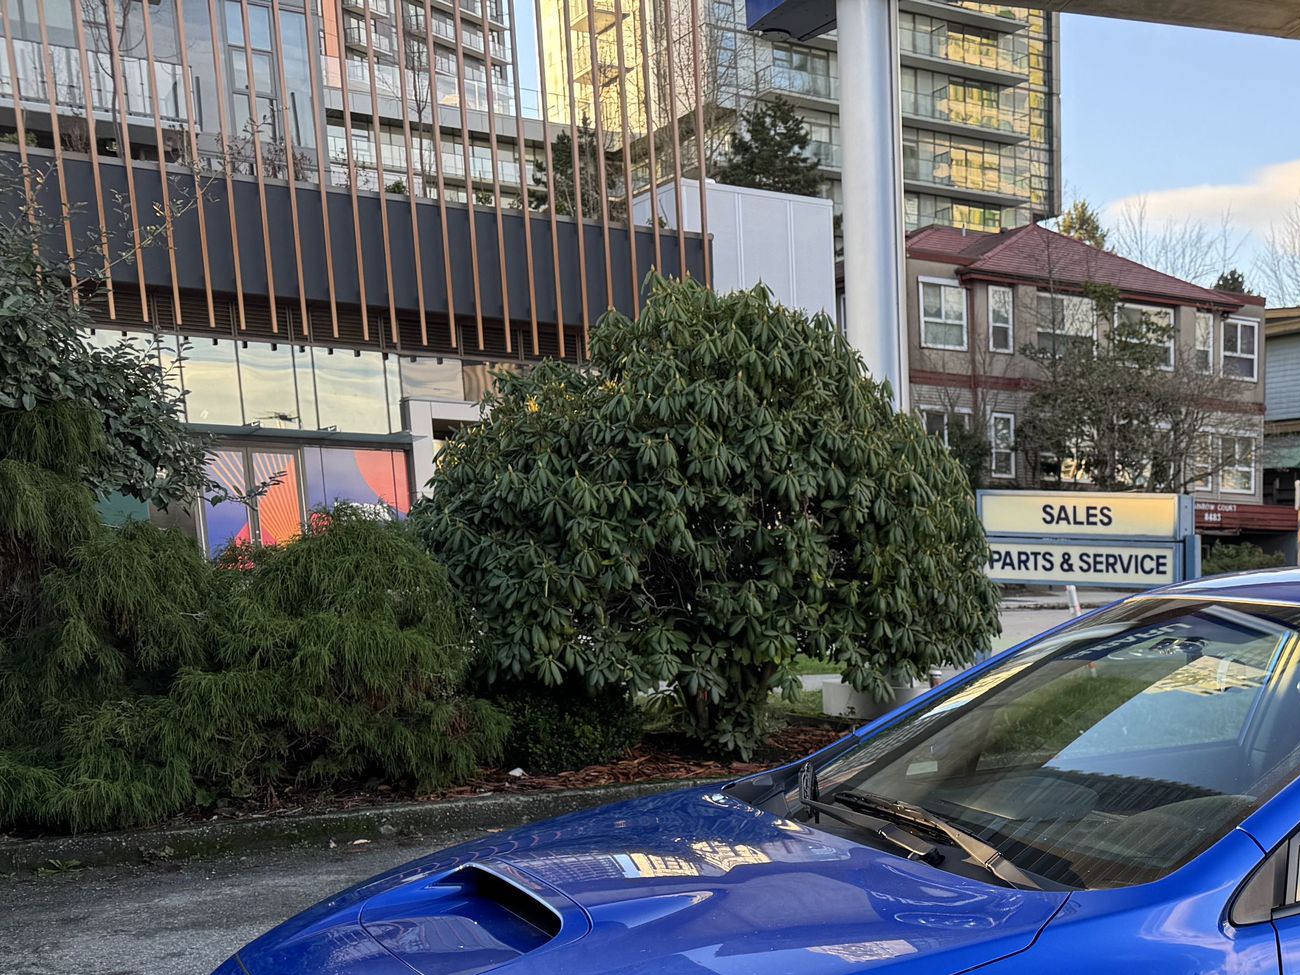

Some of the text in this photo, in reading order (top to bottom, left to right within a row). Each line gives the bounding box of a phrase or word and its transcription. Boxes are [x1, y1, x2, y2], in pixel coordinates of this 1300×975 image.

[1041, 504, 1113, 527] SALES
[1217, 504, 1237, 512] COURT
[989, 550, 1167, 575] PARTS & SERVICE
